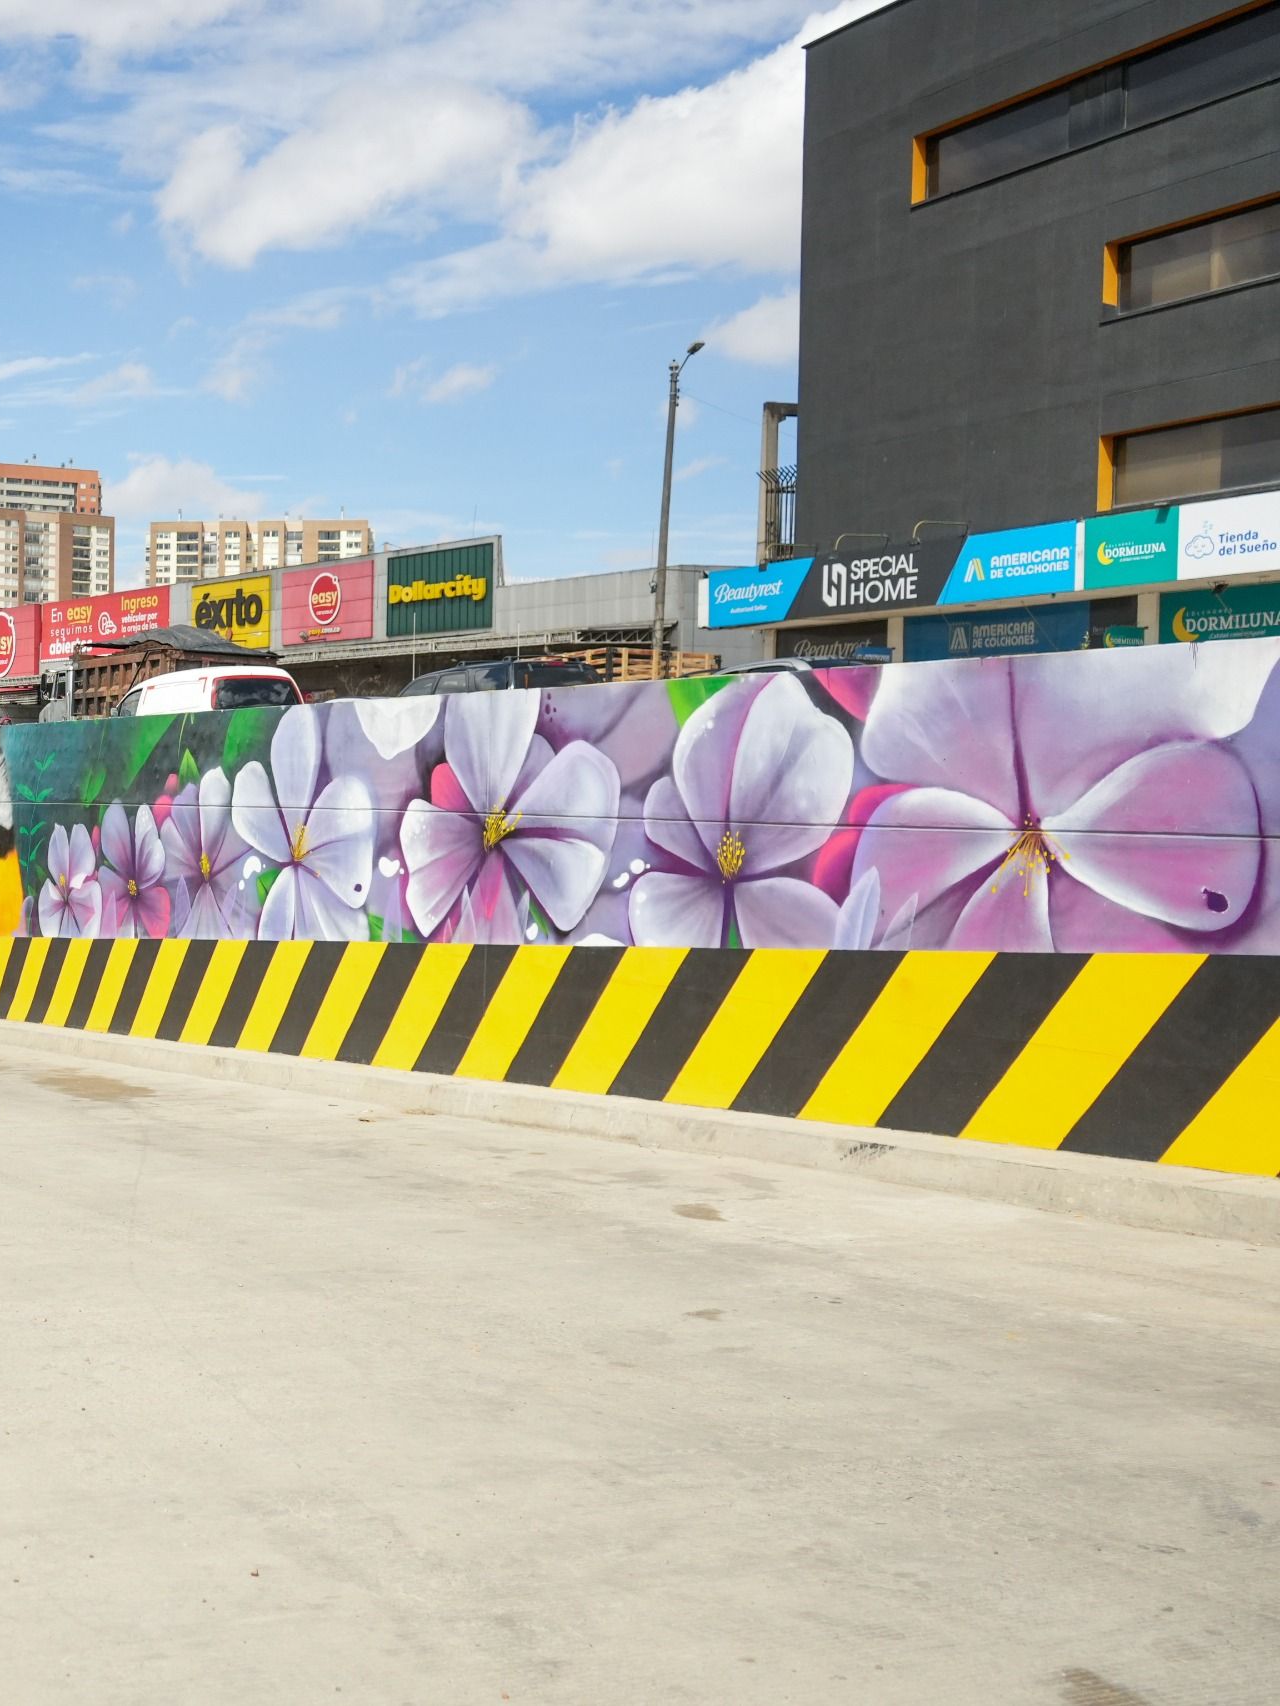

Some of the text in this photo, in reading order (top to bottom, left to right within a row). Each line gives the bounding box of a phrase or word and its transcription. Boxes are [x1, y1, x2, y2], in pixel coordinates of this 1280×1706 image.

[1218, 530, 1259, 544] Tienda
[990, 546, 1070, 568] AMERICANA
[1105, 541, 1167, 559] DORMILUNA
[1218, 545, 1236, 557] del
[850, 553, 919, 581] SPECIAL
[990, 560, 1070, 579] DE COLCHONES
[388, 574, 487, 604] Dollarcity
[714, 579, 783, 604] Beautyrest
[850, 576, 918, 605] HOME
[121, 595, 158, 614] Ingreso
[312, 591, 338, 606] easy
[51, 605, 92, 624] En easy
[121, 612, 158, 623] vehicular por
[195, 589, 263, 630] éxito
[50, 625, 93, 639] seguimos
[121, 621, 158, 633] la oreja de las
[972, 621, 1035, 638] AMERICANA
[972, 632, 1035, 649] DE COLCHONES
